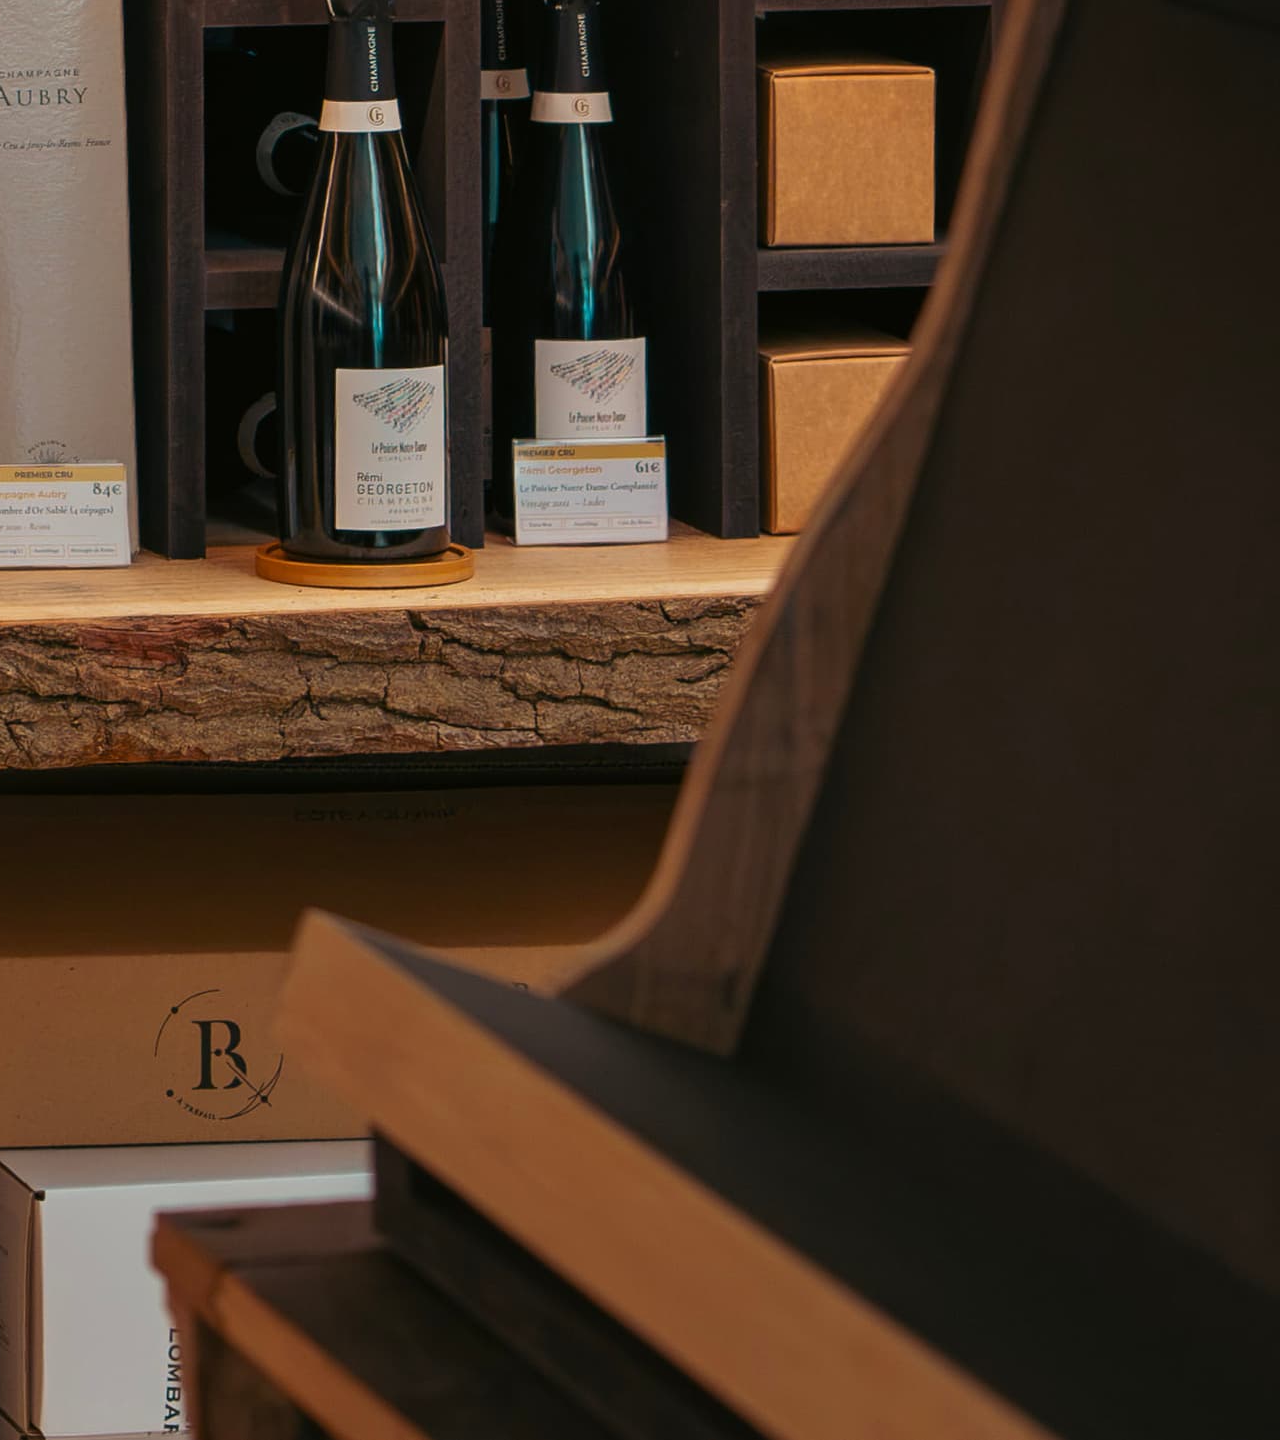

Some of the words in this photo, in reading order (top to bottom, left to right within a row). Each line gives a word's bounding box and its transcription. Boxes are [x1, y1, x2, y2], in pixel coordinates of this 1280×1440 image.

[577, 13, 589, 77] CHAMPAGNE
[368, 26, 378, 92] CHAMPAGNE
[635, 461, 660, 473] 61€
[357, 472, 383, 482] Rémi
[92, 483, 121, 497] 84€
[357, 482, 433, 495] GEORGETON
[192, 1020, 247, 1090] B
